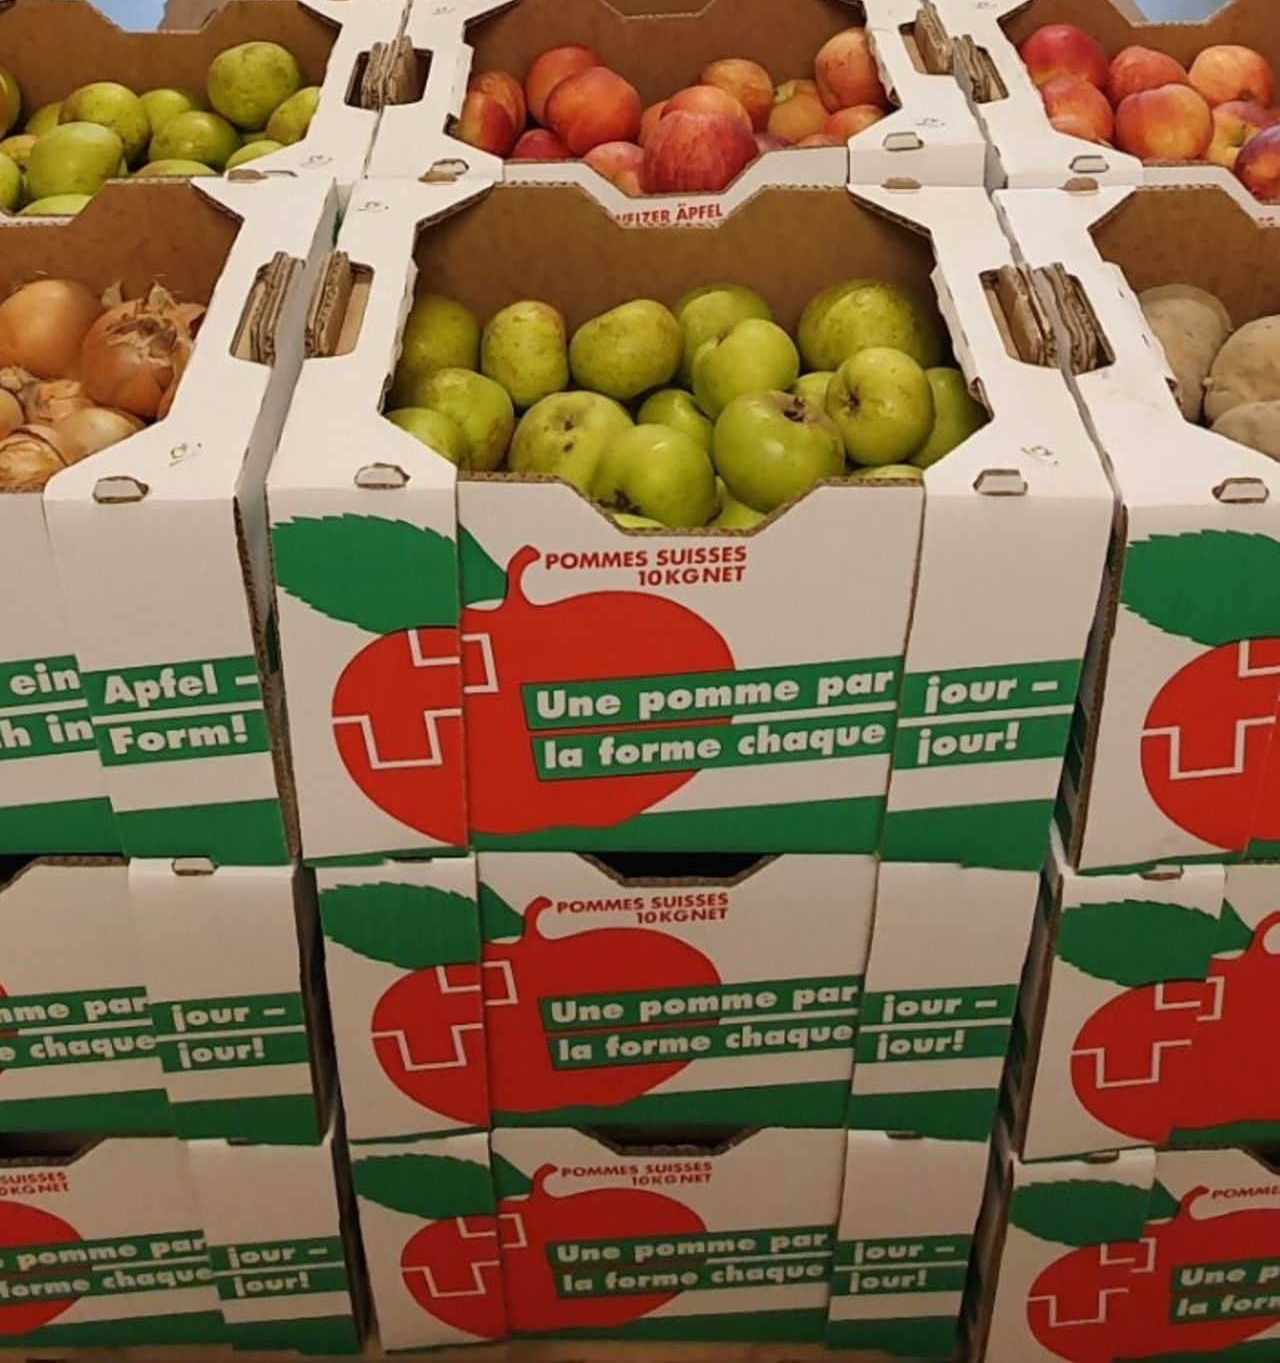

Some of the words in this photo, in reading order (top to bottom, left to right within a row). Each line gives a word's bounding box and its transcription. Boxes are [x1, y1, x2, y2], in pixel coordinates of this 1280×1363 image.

[545, 550, 648, 569] POMMES
[657, 546, 747, 566] SUISSES
[10, 663, 80, 695] ein
[104, 664, 218, 708] Apfel
[536, 691, 621, 719] Une
[638, 677, 800, 720] pomme
[817, 668, 894, 704] par
[923, 676, 1016, 714] jour
[47, 714, 94, 744] in
[109, 714, 248, 755] Form!
[544, 741, 583, 769] la
[598, 737, 721, 766] forme
[738, 722, 886, 756] chaque
[917, 722, 1020, 763] jour!
[556, 898, 645, 913] POMMES
[651, 893, 729, 909] SUISSES
[84, 994, 147, 1022] par
[172, 1004, 249, 1032] jour
[551, 1001, 624, 1023] Une
[640, 989, 777, 1023] pomme
[792, 983, 859, 1009] par
[883, 994, 961, 1021] jour
[29, 1035, 157, 1060] chaque
[179, 1037, 265, 1068] jour!
[559, 1039, 592, 1061] la
[606, 1032, 712, 1057] forme
[725, 1022, 854, 1049] chaque
[877, 1030, 964, 1060] jour!
[0, 1171, 67, 1186] SUISSES
[561, 1165, 639, 1178] POMMES
[645, 1161, 712, 1174] SUISSES
[16, 1242, 137, 1272] pomme
[150, 1235, 207, 1260] par
[228, 1244, 295, 1270] jour
[557, 1243, 620, 1262] Une
[634, 1235, 756, 1262] pomme
[770, 1230, 828, 1253] par
[854, 1240, 923, 1264] jour
[102, 1267, 214, 1290] chaque
[234, 1272, 309, 1297] jour!
[563, 1274, 593, 1291] la
[605, 1269, 698, 1289] forme
[710, 1260, 824, 1284] chaque
[849, 1269, 927, 1293] jour!
[1180, 1267, 1246, 1287] Une
[1177, 1297, 1207, 1317] la
